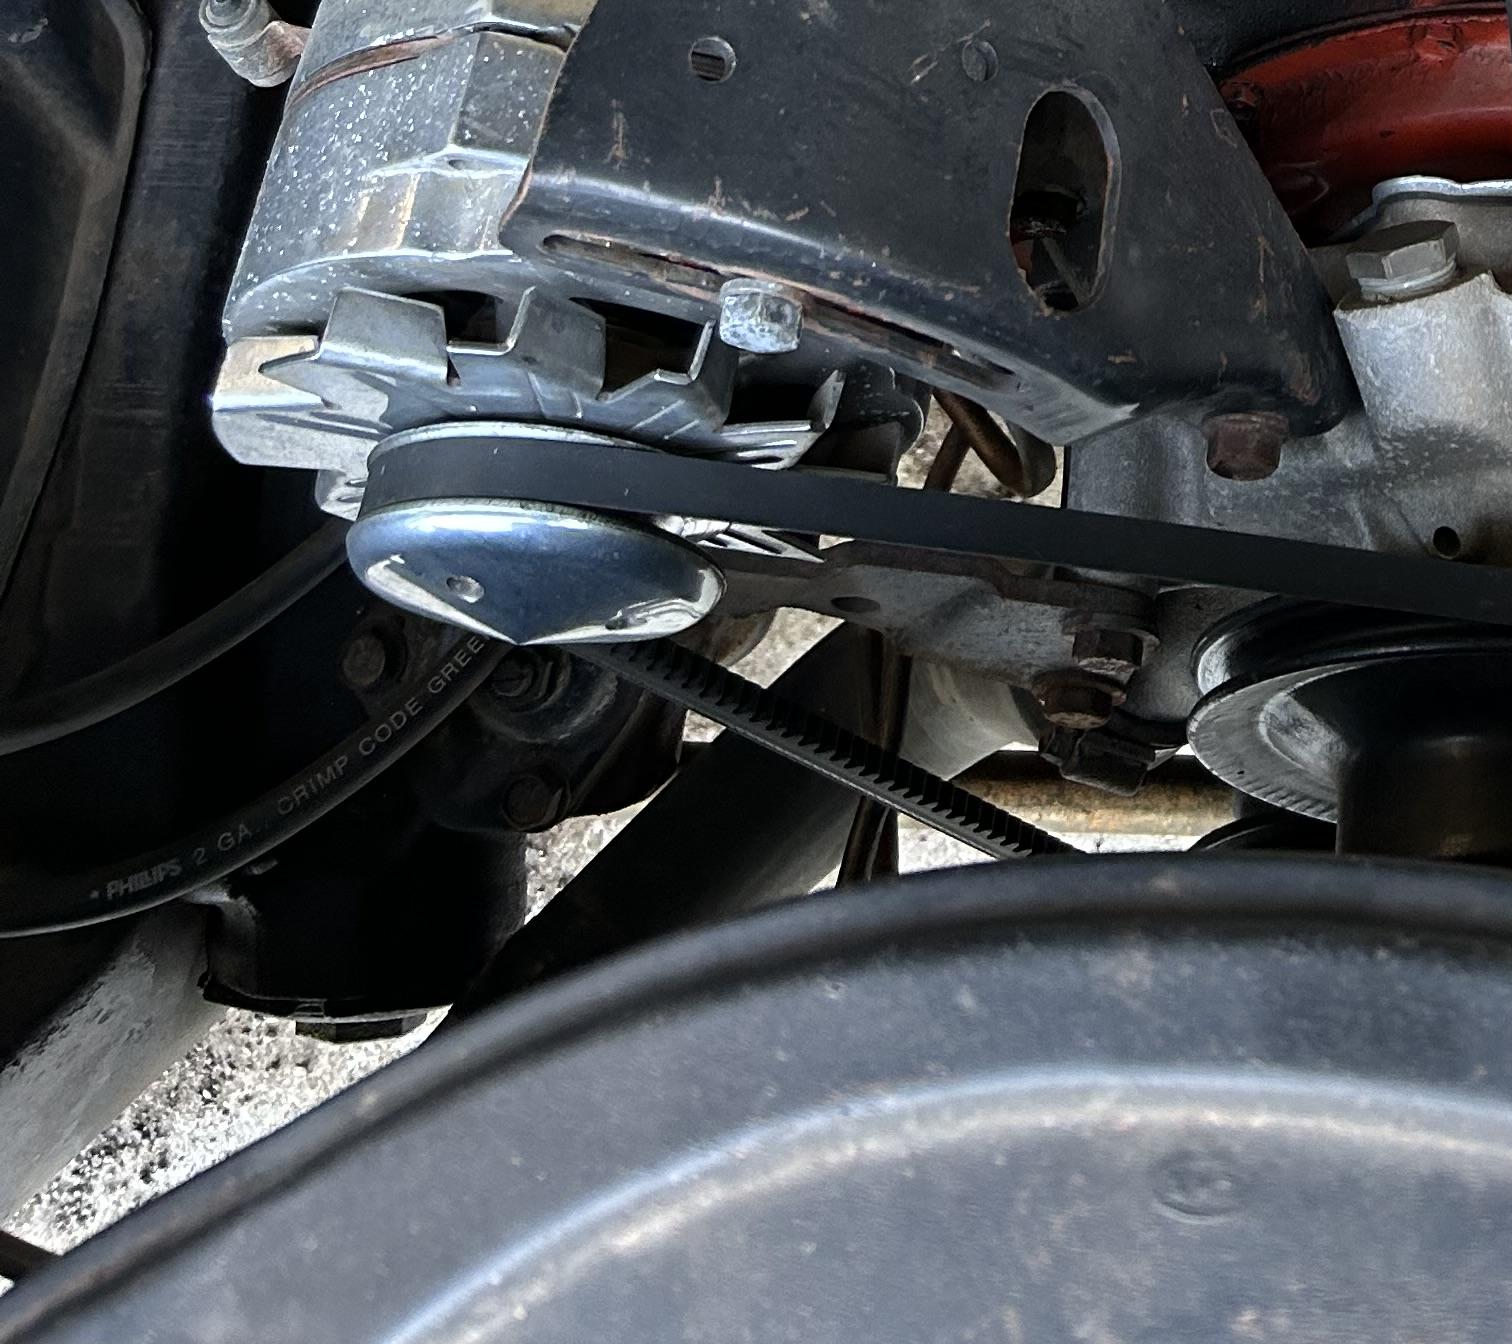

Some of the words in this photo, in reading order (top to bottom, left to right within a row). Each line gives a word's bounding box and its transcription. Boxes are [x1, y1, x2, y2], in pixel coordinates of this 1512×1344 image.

[192, 847, 207, 866] 2
[276, 755, 348, 816] CRIMP
[358, 697, 424, 756] CODE
[426, 634, 490, 695] GREE
